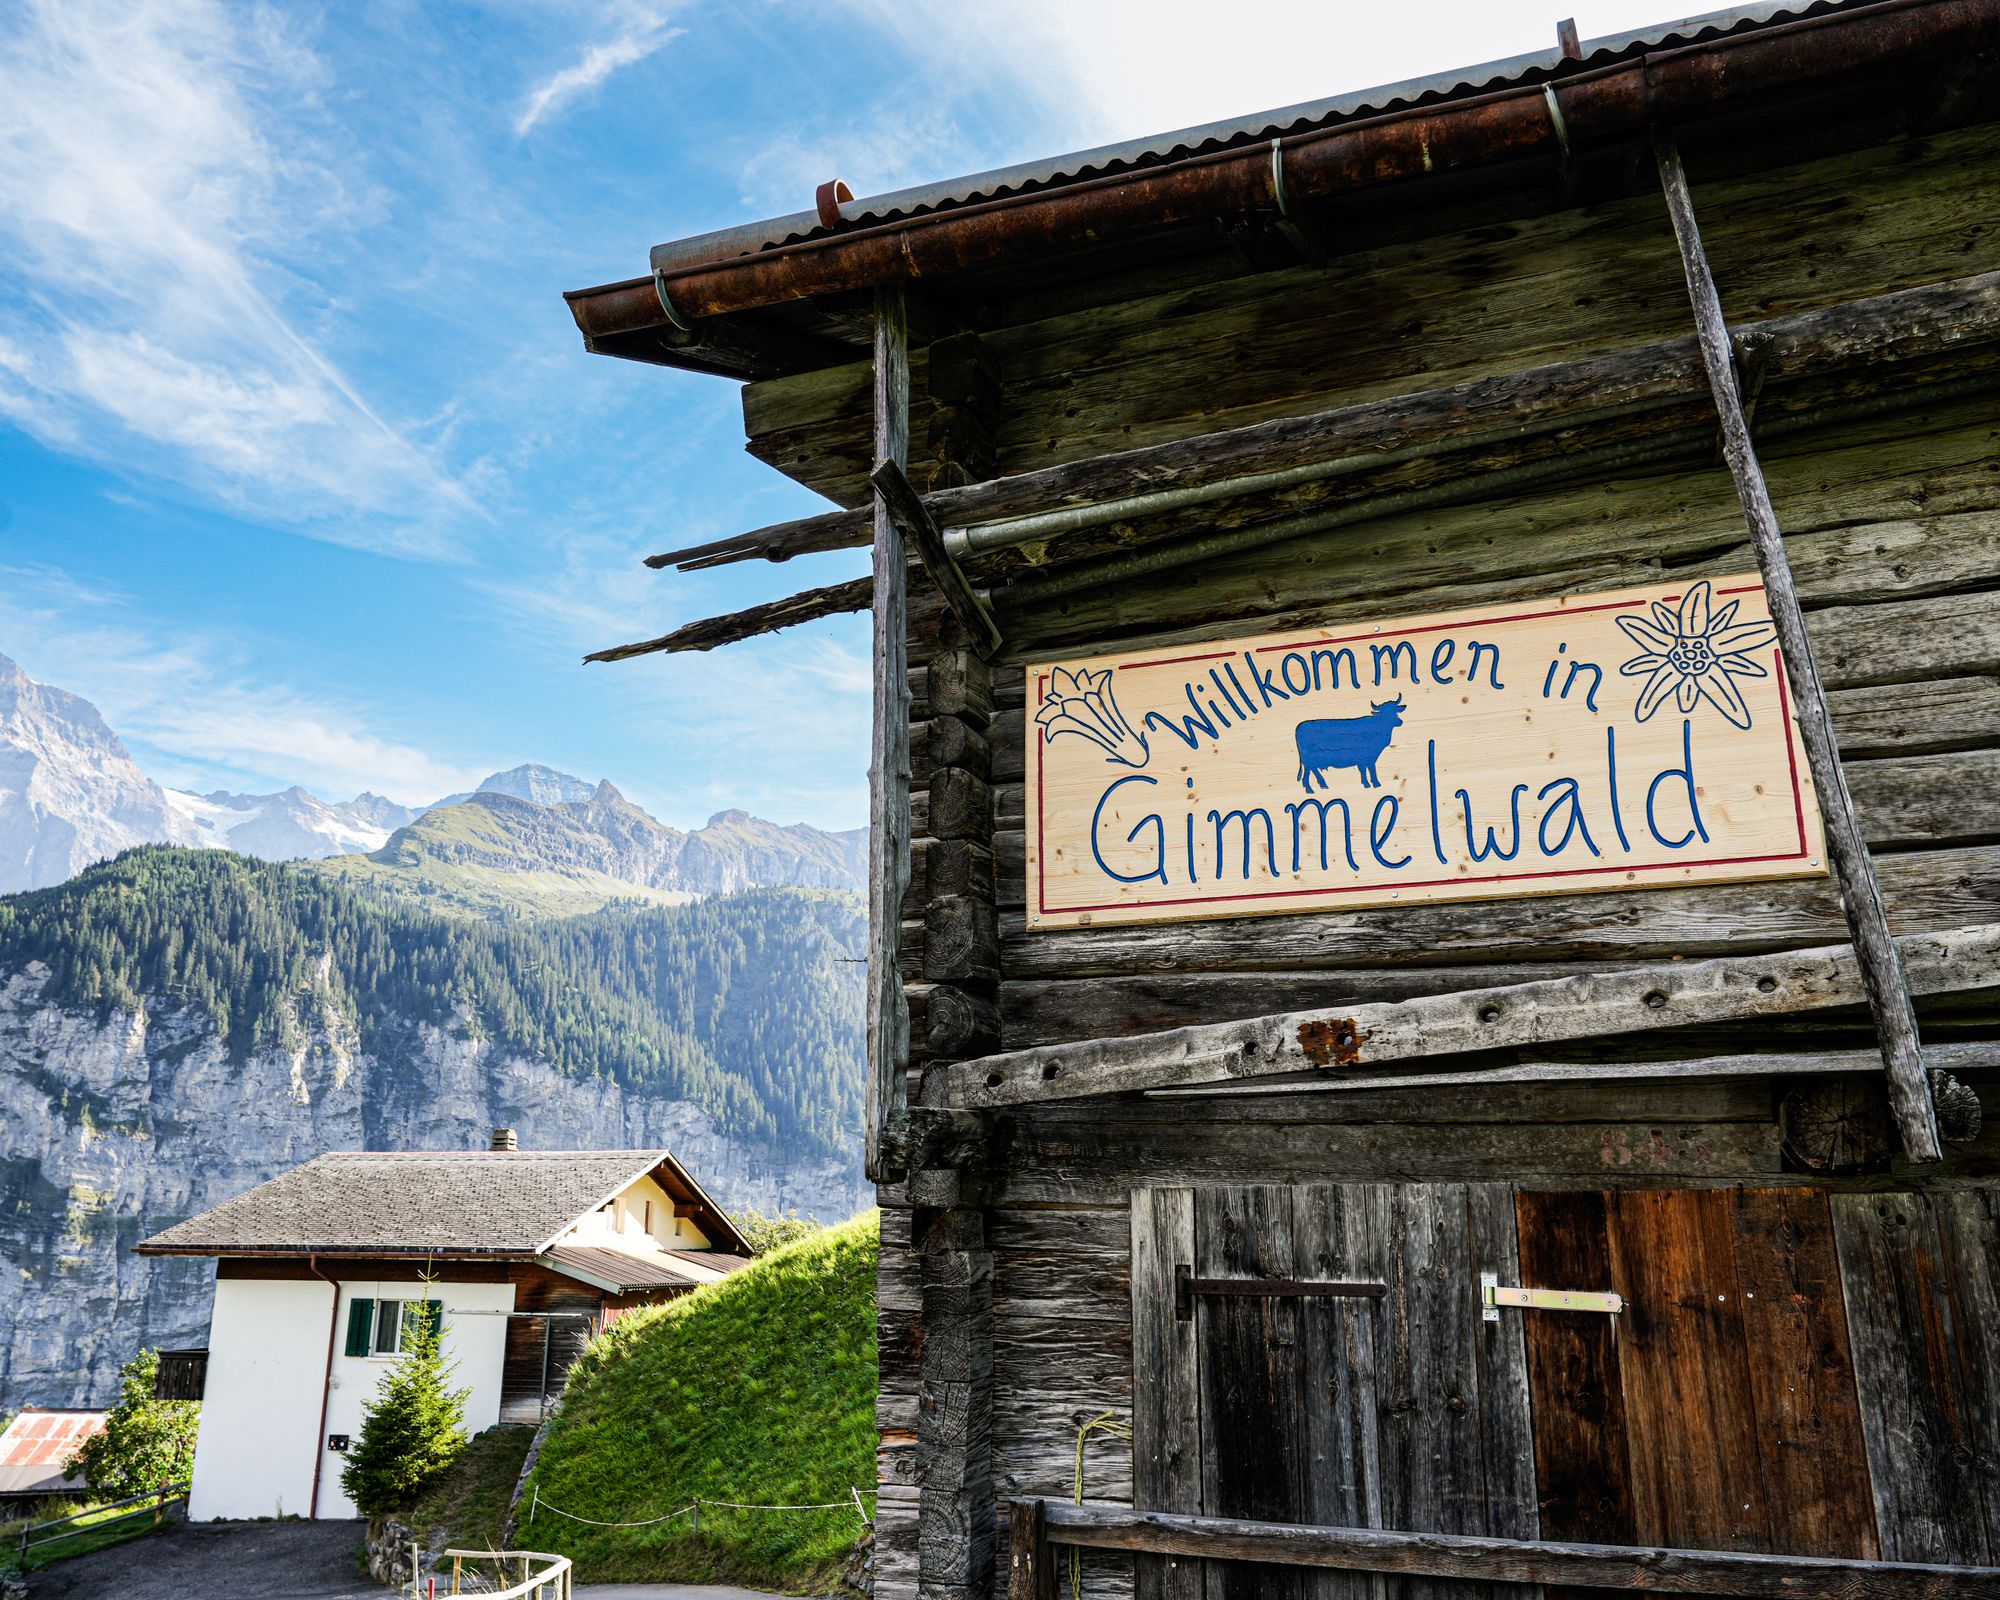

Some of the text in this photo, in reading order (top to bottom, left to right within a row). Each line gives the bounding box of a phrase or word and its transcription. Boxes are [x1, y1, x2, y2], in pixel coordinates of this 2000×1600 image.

[1144, 639, 1603, 750] Willkommen in
[1091, 719, 1711, 885] Gimmelwald
